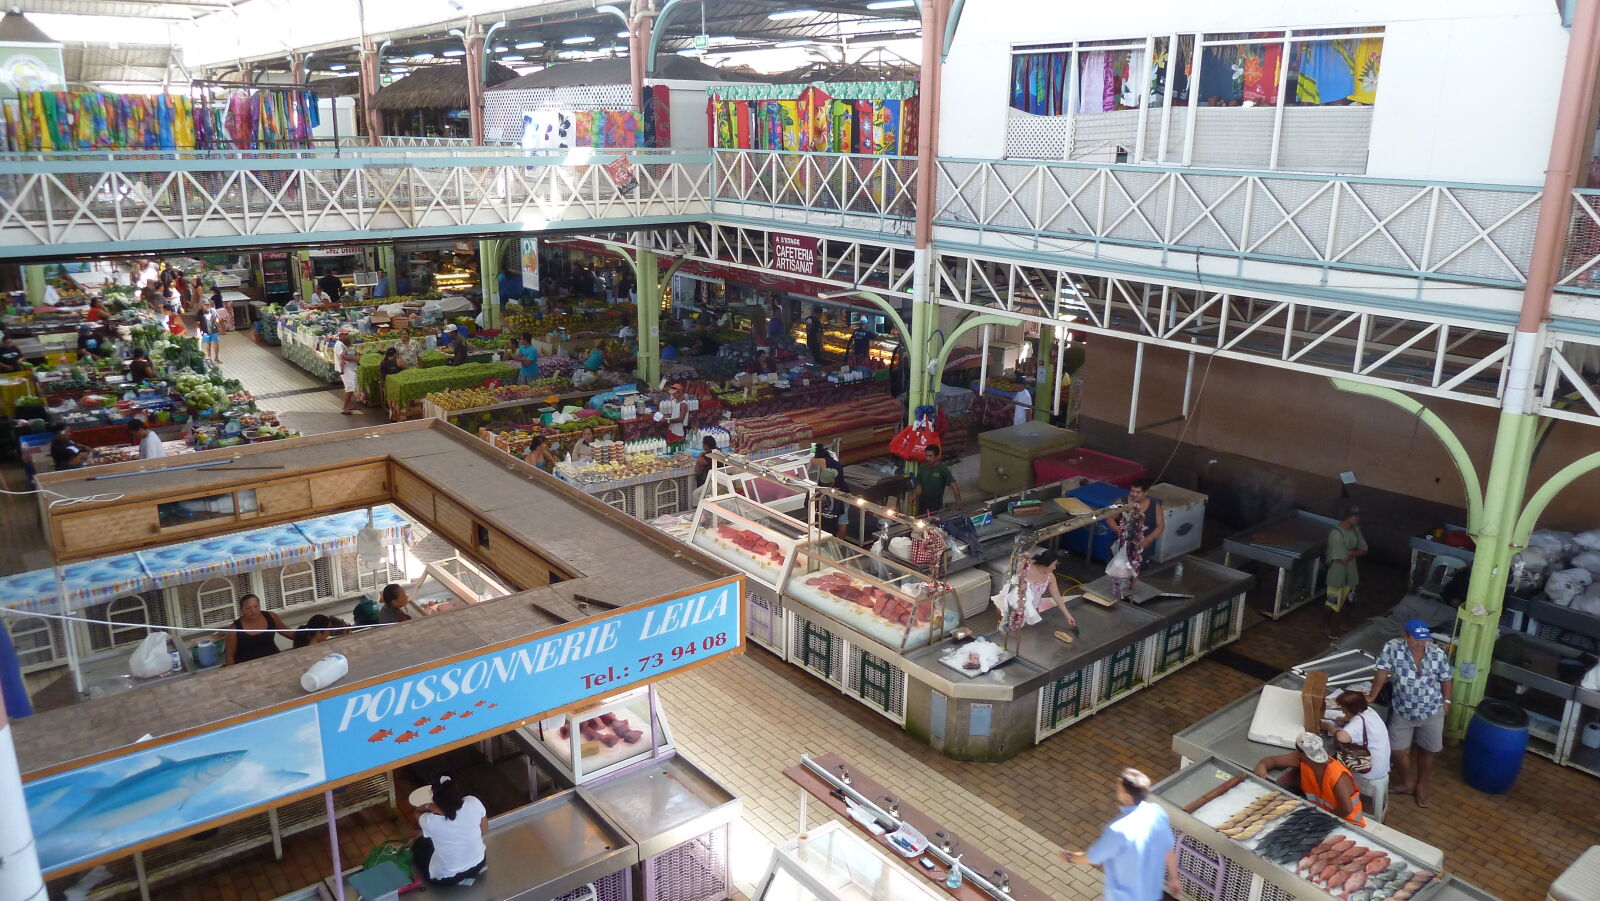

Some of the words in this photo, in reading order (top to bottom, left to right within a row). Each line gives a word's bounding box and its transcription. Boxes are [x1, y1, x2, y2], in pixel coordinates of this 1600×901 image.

[776, 245, 814, 262] CAFETERIA
[776, 257, 814, 274] ARTISANAT
[338, 620, 621, 733] POISSONNERIE
[639, 589, 729, 641] LEILA
[581, 664, 629, 690] Tel.:
[638, 651, 664, 673] 73
[671, 641, 697, 661] 94
[702, 631, 728, 650] 08
